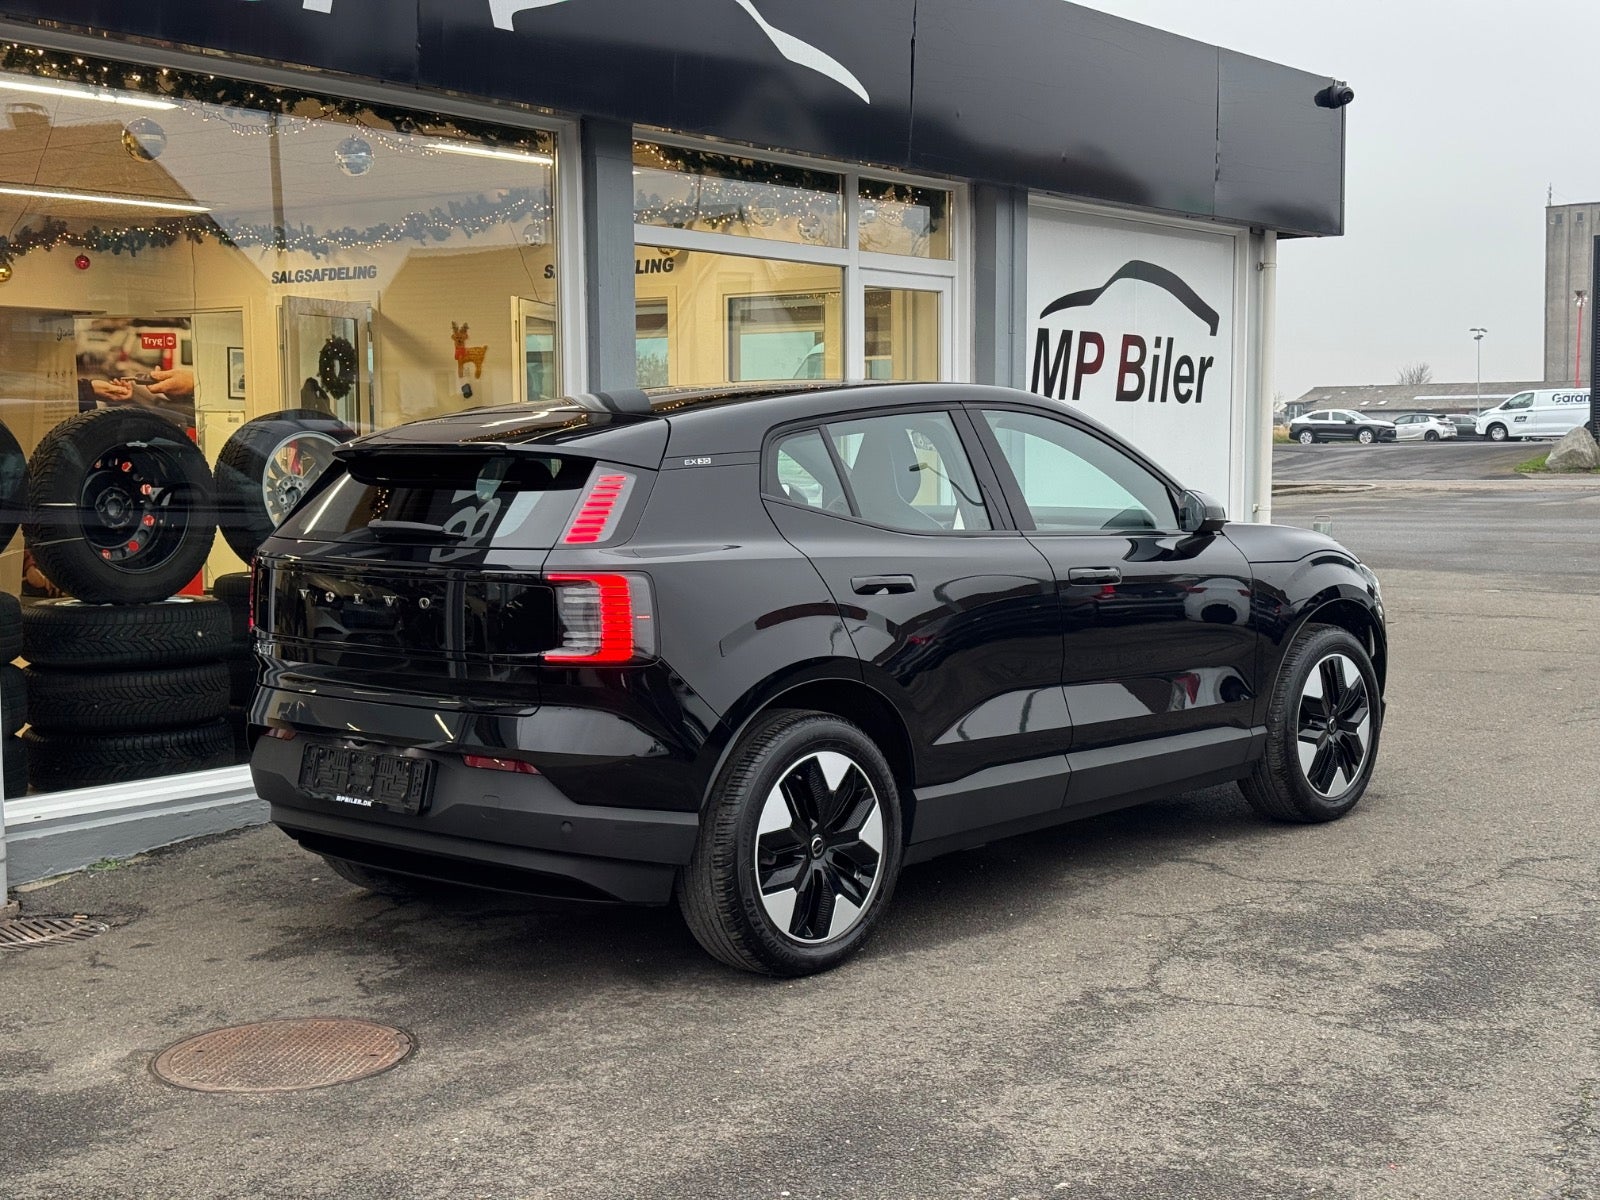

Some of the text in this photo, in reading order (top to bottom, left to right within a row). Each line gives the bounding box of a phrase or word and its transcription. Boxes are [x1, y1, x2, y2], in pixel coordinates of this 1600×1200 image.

[272, 265, 377, 284] SALGSAFDELING
[143, 336, 163, 347] Tryg
[1031, 328, 1214, 404] MP Biler
[684, 457, 712, 466] EX30
[299, 588, 432, 610] VOLVO
